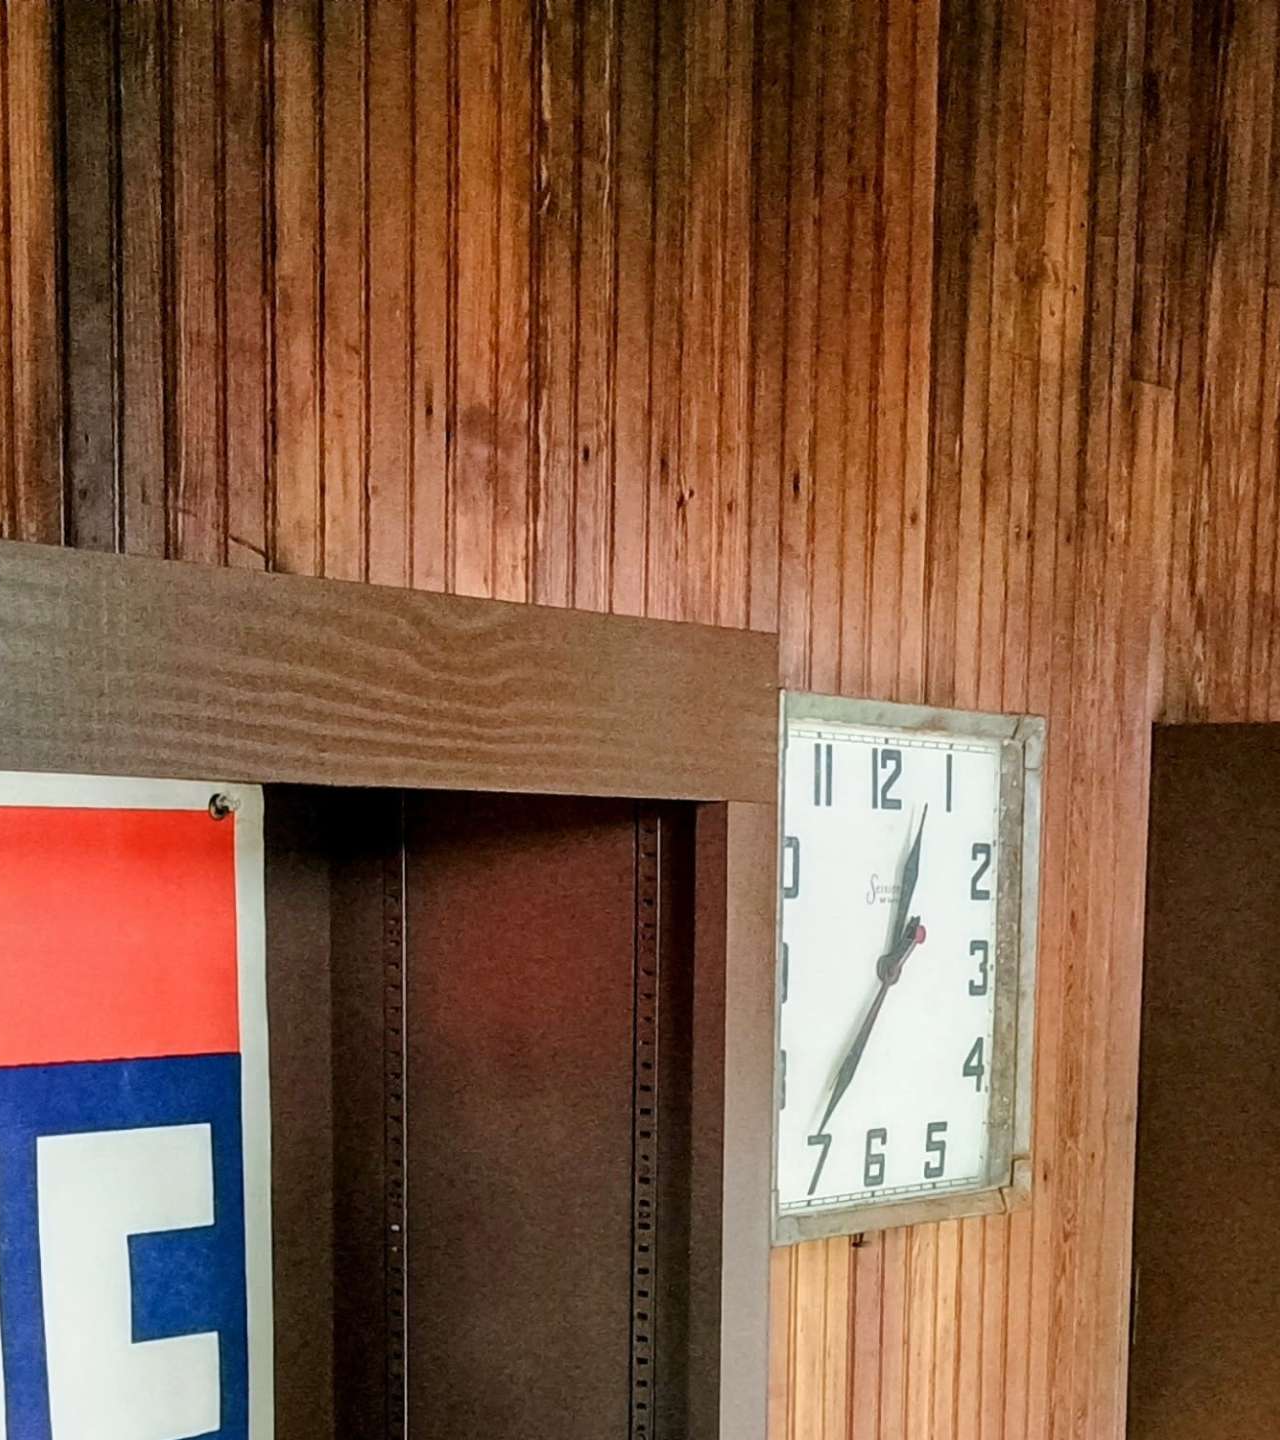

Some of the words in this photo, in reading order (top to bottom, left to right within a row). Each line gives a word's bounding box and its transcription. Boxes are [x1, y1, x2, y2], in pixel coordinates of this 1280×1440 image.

[813, 743, 833, 807] 11
[871, 747, 903, 810] 12
[945, 753, 953, 813] 1
[970, 843, 992, 900] 2
[968, 940, 989, 997] 3
[962, 1036, 985, 1092] 4
[807, 1134, 833, 1196] 7
[863, 1128, 887, 1187] 6
[923, 1121, 948, 1179] 5
